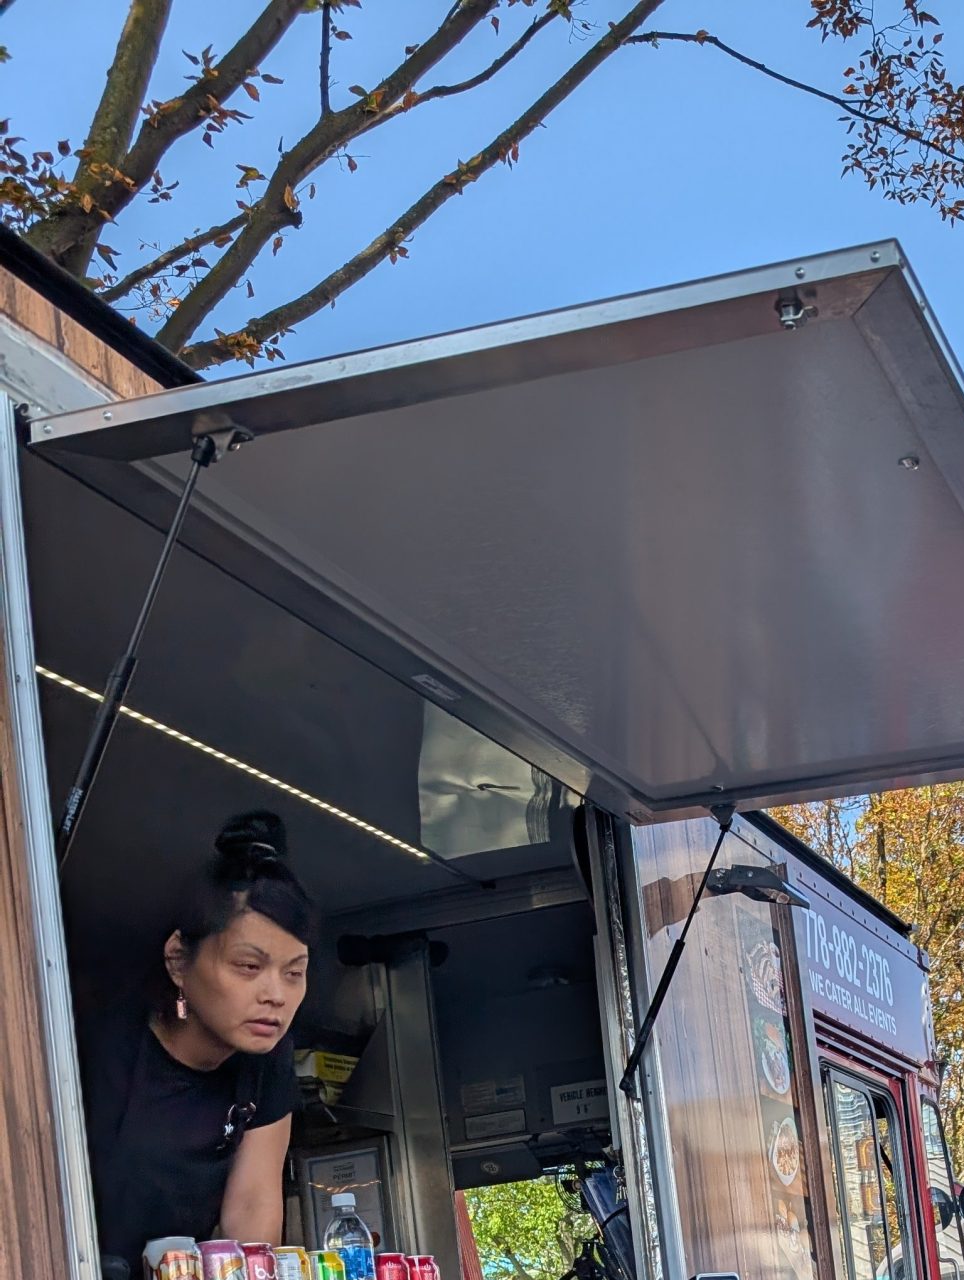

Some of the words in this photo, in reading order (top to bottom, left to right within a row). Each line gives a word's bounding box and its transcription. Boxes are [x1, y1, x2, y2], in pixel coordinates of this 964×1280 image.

[802, 909, 893, 1006] 778-882-2376
[808, 968, 824, 997] WE
[825, 979, 852, 1013] CATER
[854, 995, 868, 1020] ALL
[868, 1003, 897, 1036] EVENTS
